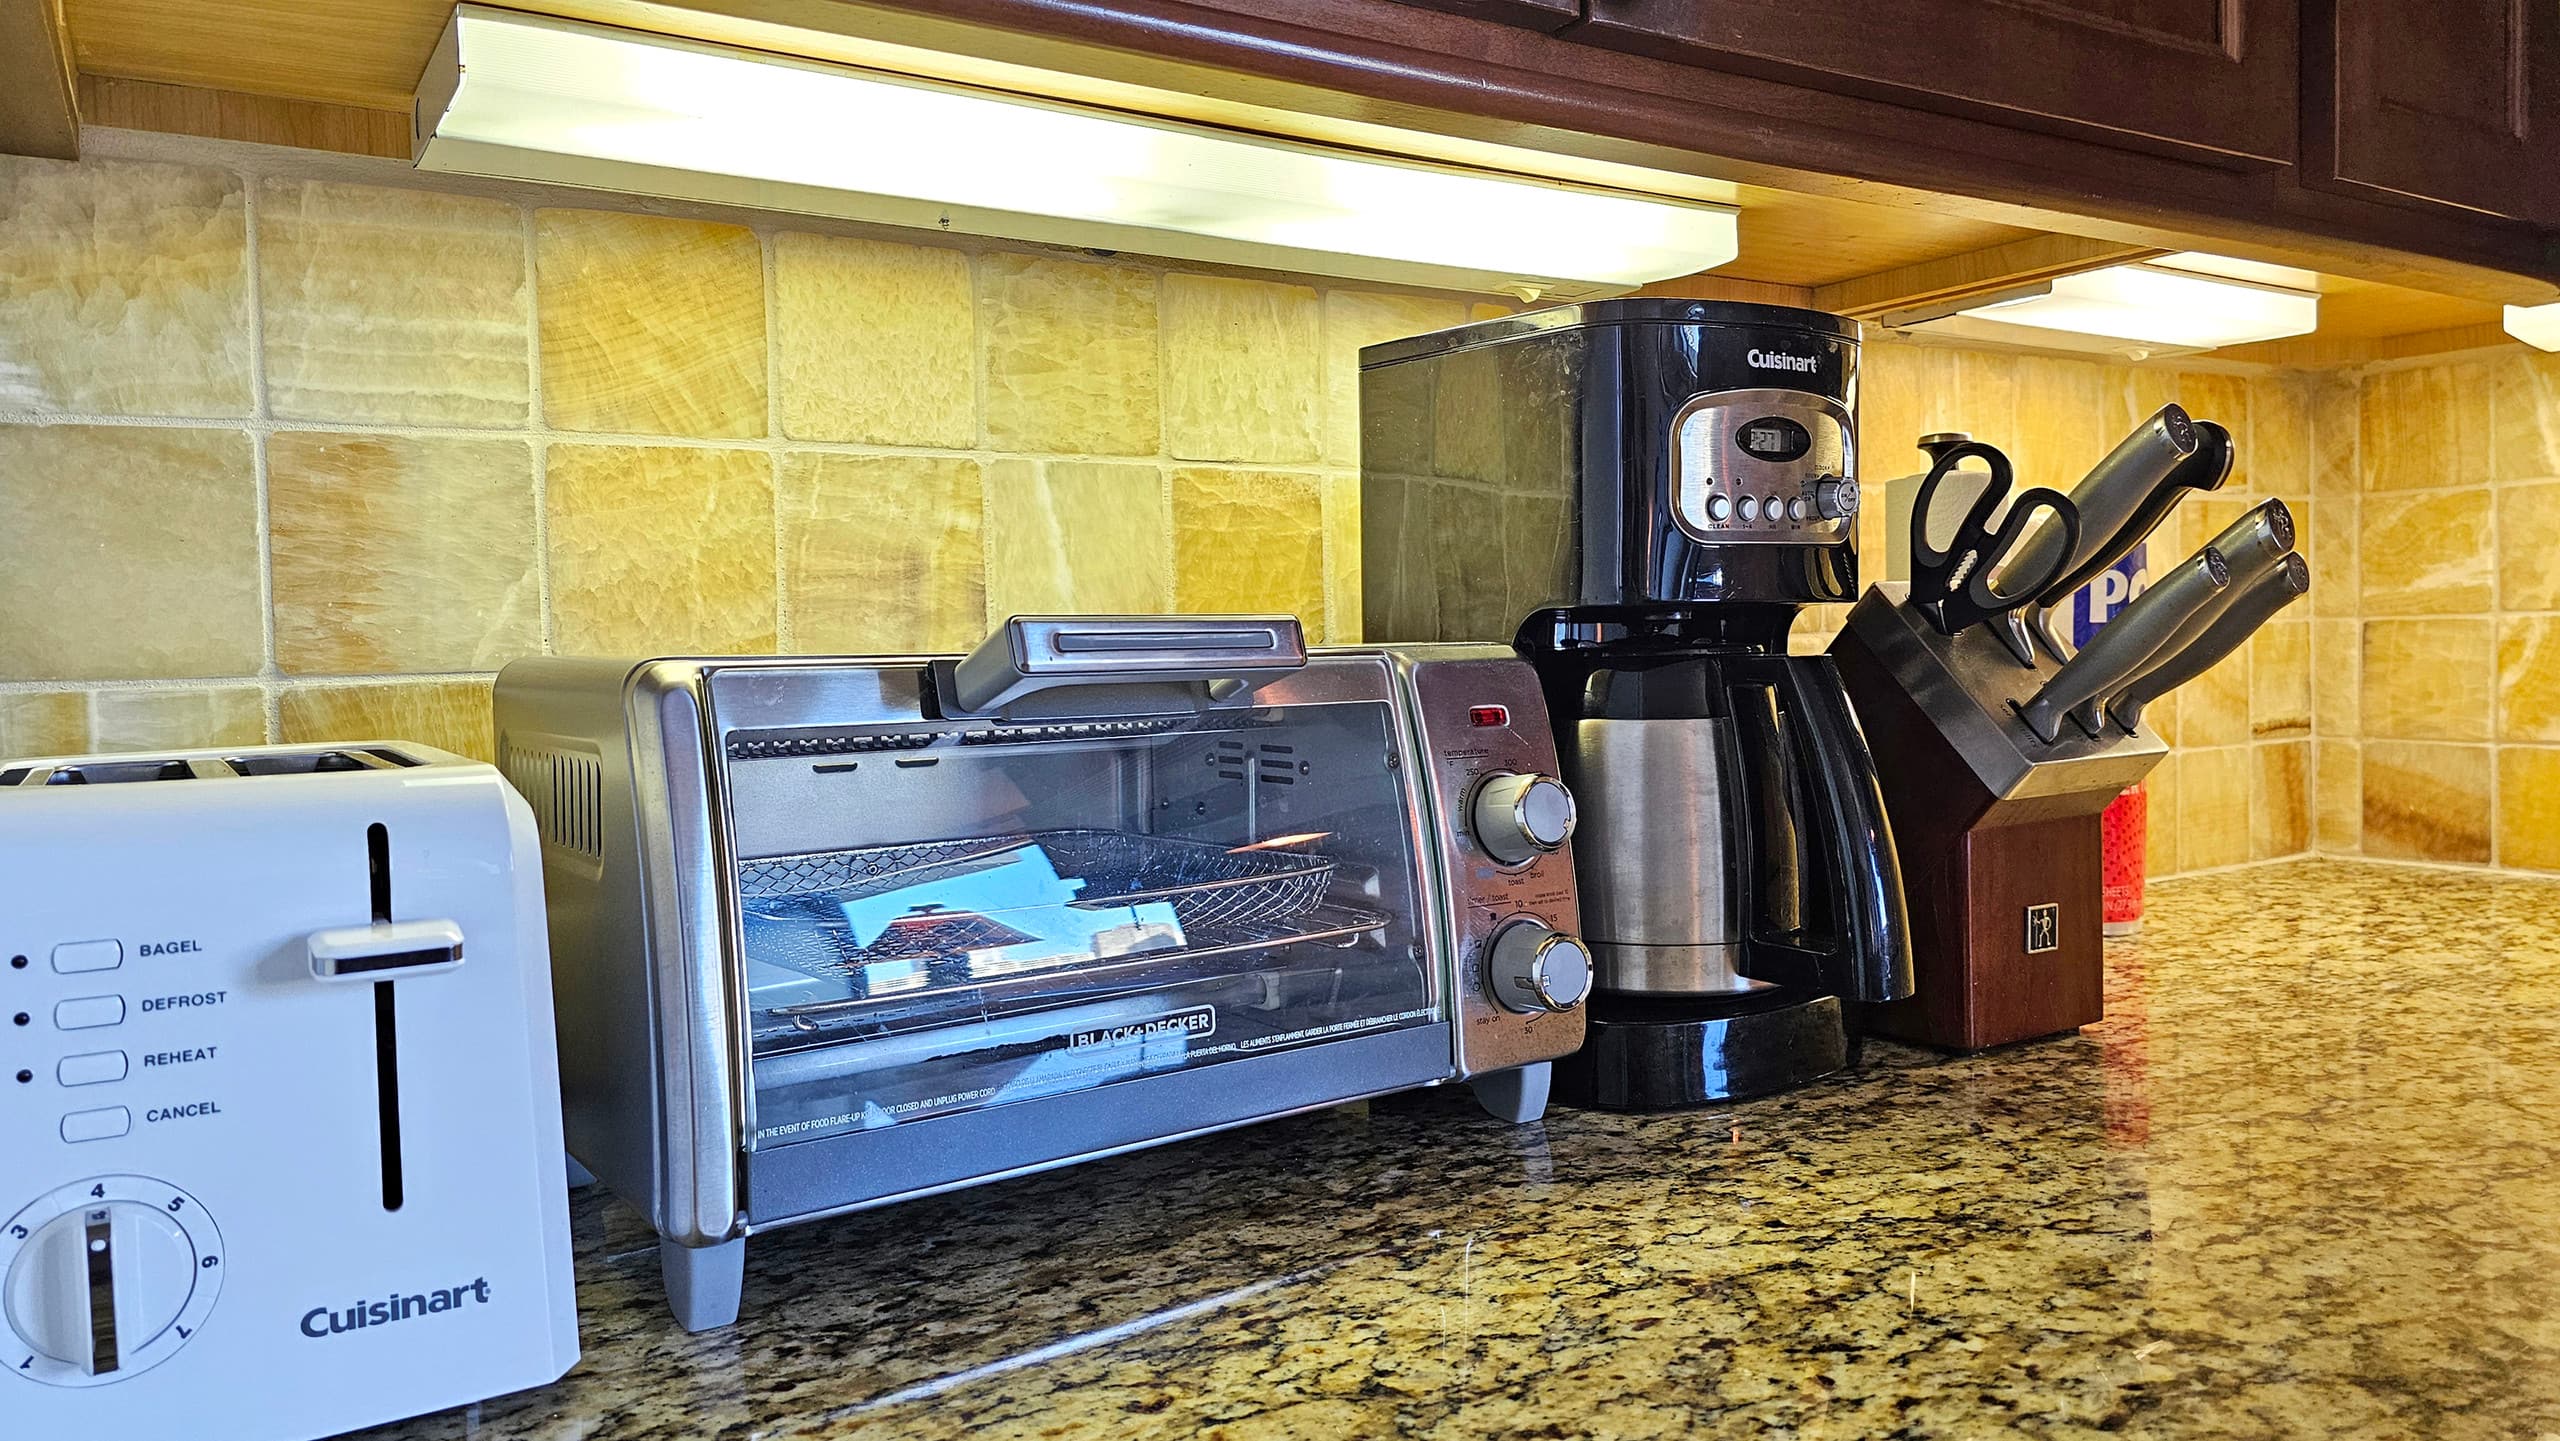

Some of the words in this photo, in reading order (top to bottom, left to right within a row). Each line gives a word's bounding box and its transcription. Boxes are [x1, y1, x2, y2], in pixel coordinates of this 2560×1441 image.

[1747, 348, 1816, 374] Cuisinart
[1444, 748, 1489, 757] temperature
[1504, 759, 1517, 767] 300
[1466, 768, 1479, 776] 250
[1457, 787, 1467, 812] warm
[1530, 871, 1544, 879] broil
[1515, 900, 1523, 908] 10
[1550, 914, 1558, 922] 15
[139, 940, 202, 957] BAGEL
[142, 991, 227, 1012] DEFROST
[1476, 1017, 1490, 1026] stay
[1078, 1013, 1209, 1048] BLACK+DECKER
[1240, 1040, 1249, 1049] LES
[1250, 1035, 1271, 1048] ALIMENTS
[1305, 1026, 1323, 1038] GARDER
[1329, 1023, 1343, 1033] PORTE
[1524, 1026, 1533, 1034] 30
[144, 1046, 217, 1067] REHEAT
[146, 1101, 221, 1122] CANCEL
[757, 1128, 765, 1139] IN
[766, 1124, 778, 1137] THE
[779, 1122, 800, 1135] EVENT
[801, 1120, 811, 1132] OF
[811, 1116, 829, 1130] FOOD
[830, 1110, 860, 1127] FLARE-UP
[896, 1102, 919, 1114] CLOSED
[919, 1098, 933, 1110] AND
[933, 1093, 957, 1107] UNPLUG
[957, 1090, 979, 1104] POWER
[91, 1183, 105, 1198] 4
[167, 1196, 185, 1212] 5
[10, 1224, 28, 1239] 3
[201, 1255, 219, 1268] 6
[300, 1276, 490, 1338] Cuisinart
[176, 1325, 192, 1339] 7
[19, 1355, 35, 1369] 1
